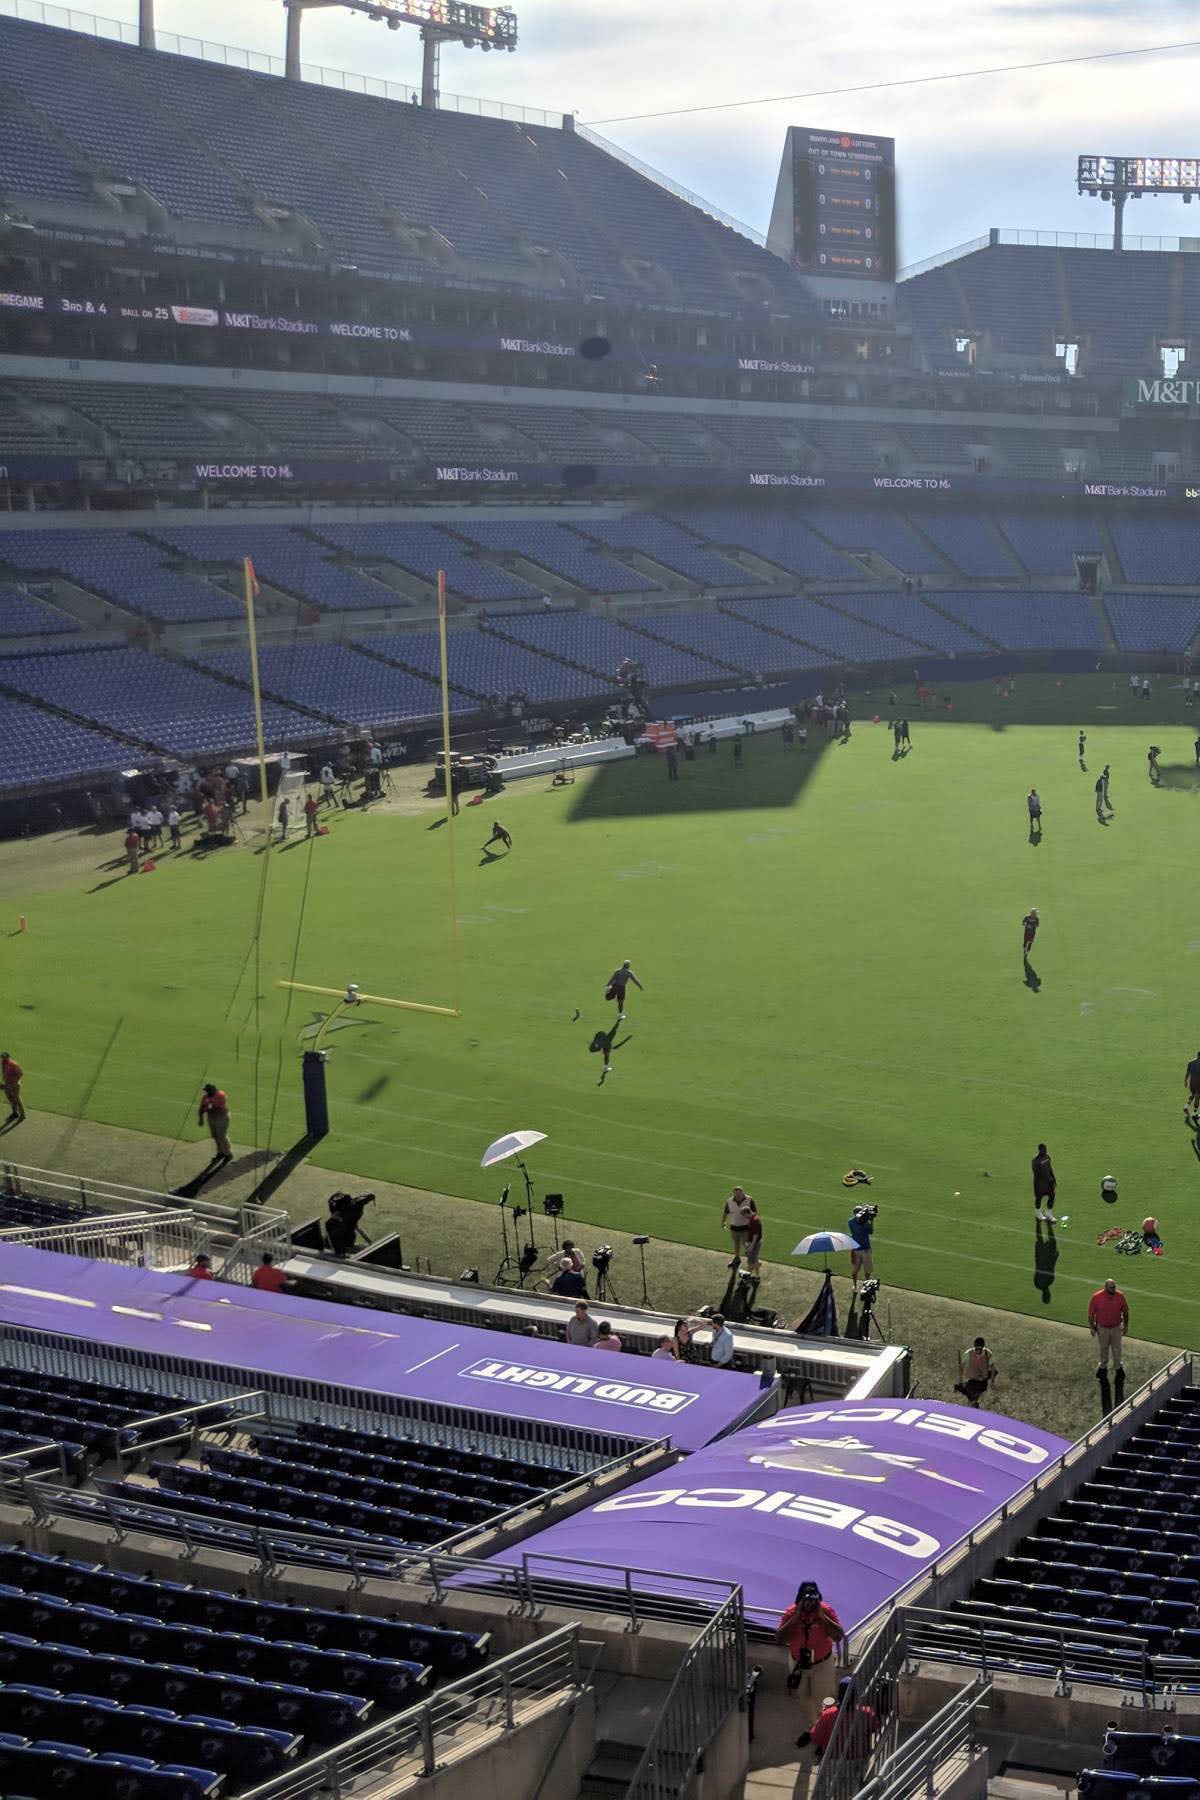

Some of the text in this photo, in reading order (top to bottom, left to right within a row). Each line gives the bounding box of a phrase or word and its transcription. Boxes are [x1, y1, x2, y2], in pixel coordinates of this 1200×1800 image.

[830, 150, 847, 158] TOWN
[819, 164, 825, 175] 0
[865, 169, 871, 180] 0
[819, 194, 825, 205] 0
[865, 199, 871, 209] 0
[820, 224, 826, 234] 0
[865, 228, 871, 239] 0
[820, 254, 826, 264] 0
[866, 257, 871, 268] 0
[86, 302, 95, 313] &
[100, 303, 107, 315] 4
[121, 308, 140, 318] BALL
[155, 307, 168, 320] 25
[225, 312, 250, 329] M&T
[252, 315, 277, 330] Bank
[278, 318, 318, 334] Stadium
[330, 324, 380, 340] WELCOME
[384, 329, 397, 340] TO
[500, 339, 575, 356] M&T Bank Stadium
[738, 358, 815, 374] M&T Bank Stadium
[1137, 379, 1194, 403] M&T
[195, 465, 257, 478] WELCOME
[260, 465, 276, 478] TO
[436, 467, 518, 481] M&T Bank Stadium
[750, 473, 825, 487] M&T Bank Stadium
[873, 478, 921, 488] WELCOME
[924, 479, 937, 489] TO
[1084, 484, 1166, 497] M&T Bank Stadium
[472, 1362, 689, 1410] BUD LIGHT
[757, 1408, 1049, 1464] GEICO
[592, 1488, 941, 1558] GEICO
